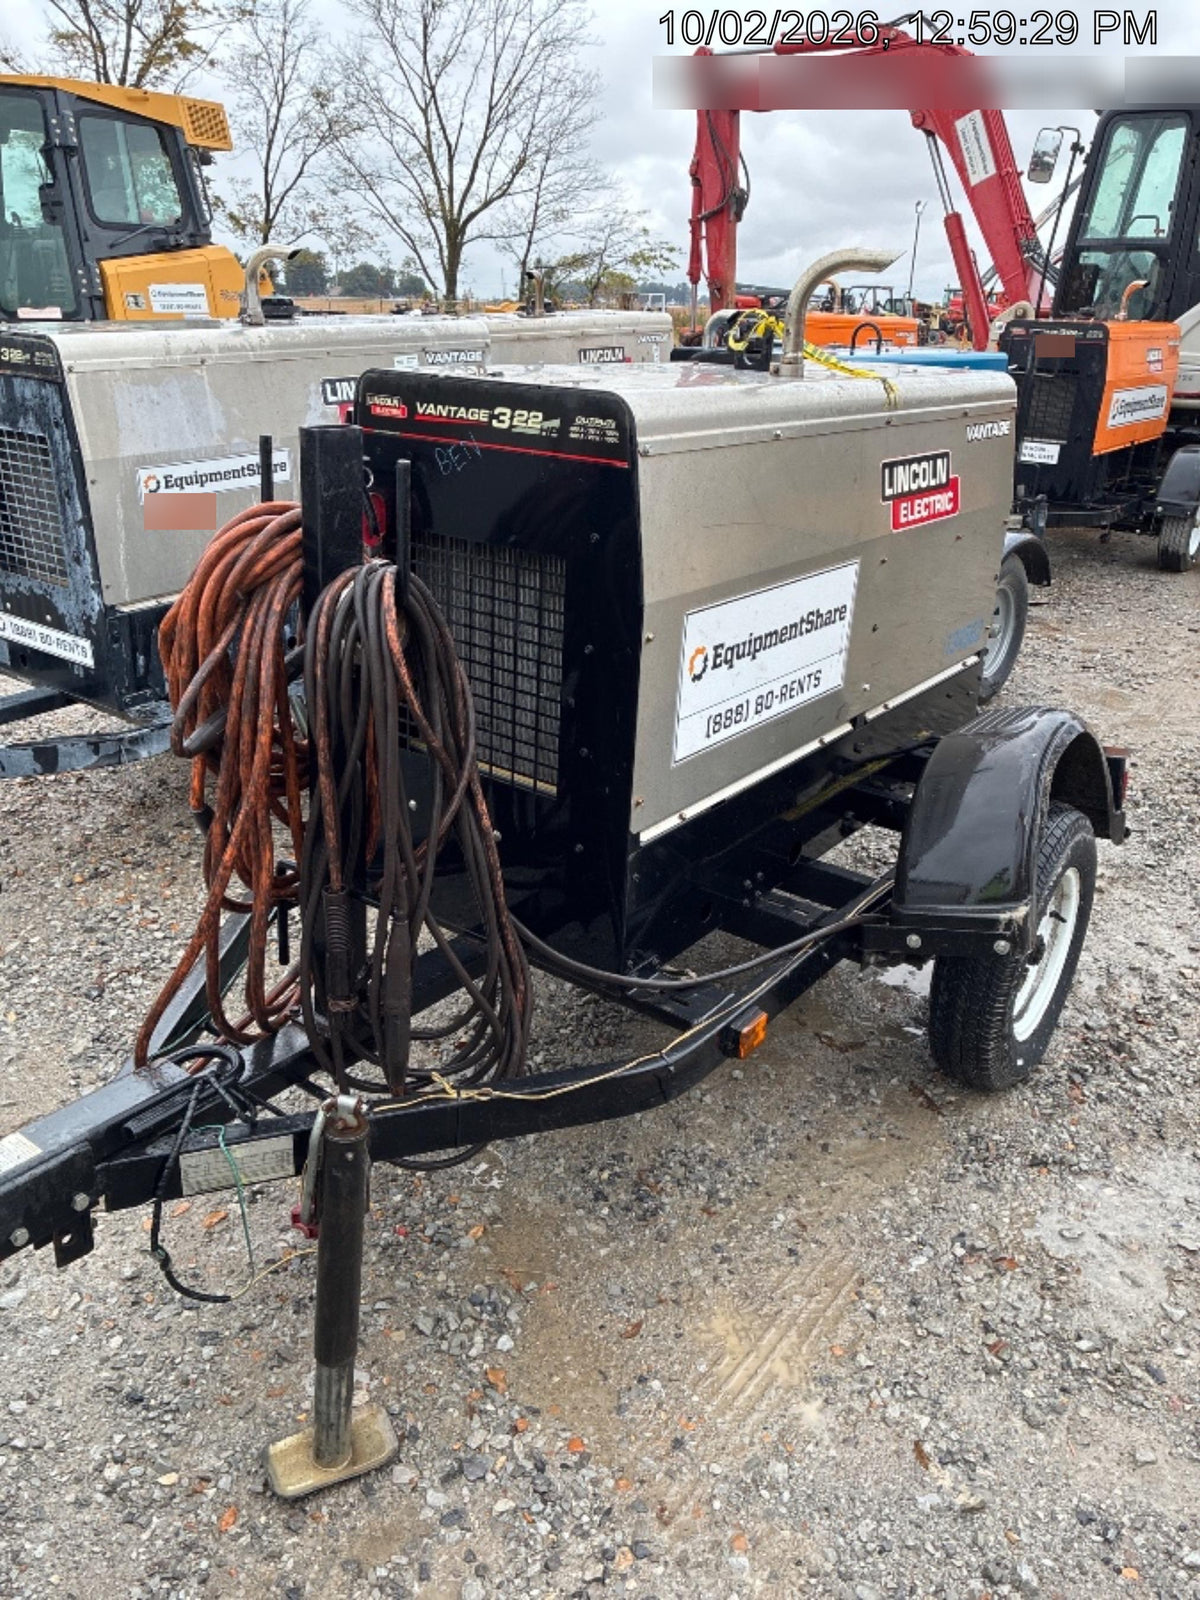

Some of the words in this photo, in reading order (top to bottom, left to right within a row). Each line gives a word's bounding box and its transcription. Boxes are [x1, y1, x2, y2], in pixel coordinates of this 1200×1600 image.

[425, 350, 483, 364] VANTAGE
[415, 401, 491, 422] VANTAGE
[491, 406, 543, 430] 322
[966, 420, 1011, 442] VANTAGE
[163, 461, 287, 491] EquipmentShre
[884, 457, 948, 497] LINCOLN
[899, 490, 954, 524] ELECTRIC
[711, 604, 847, 671] EquipmentShare
[705, 700, 750, 738] (888)
[754, 669, 822, 716] 80-RENTS
